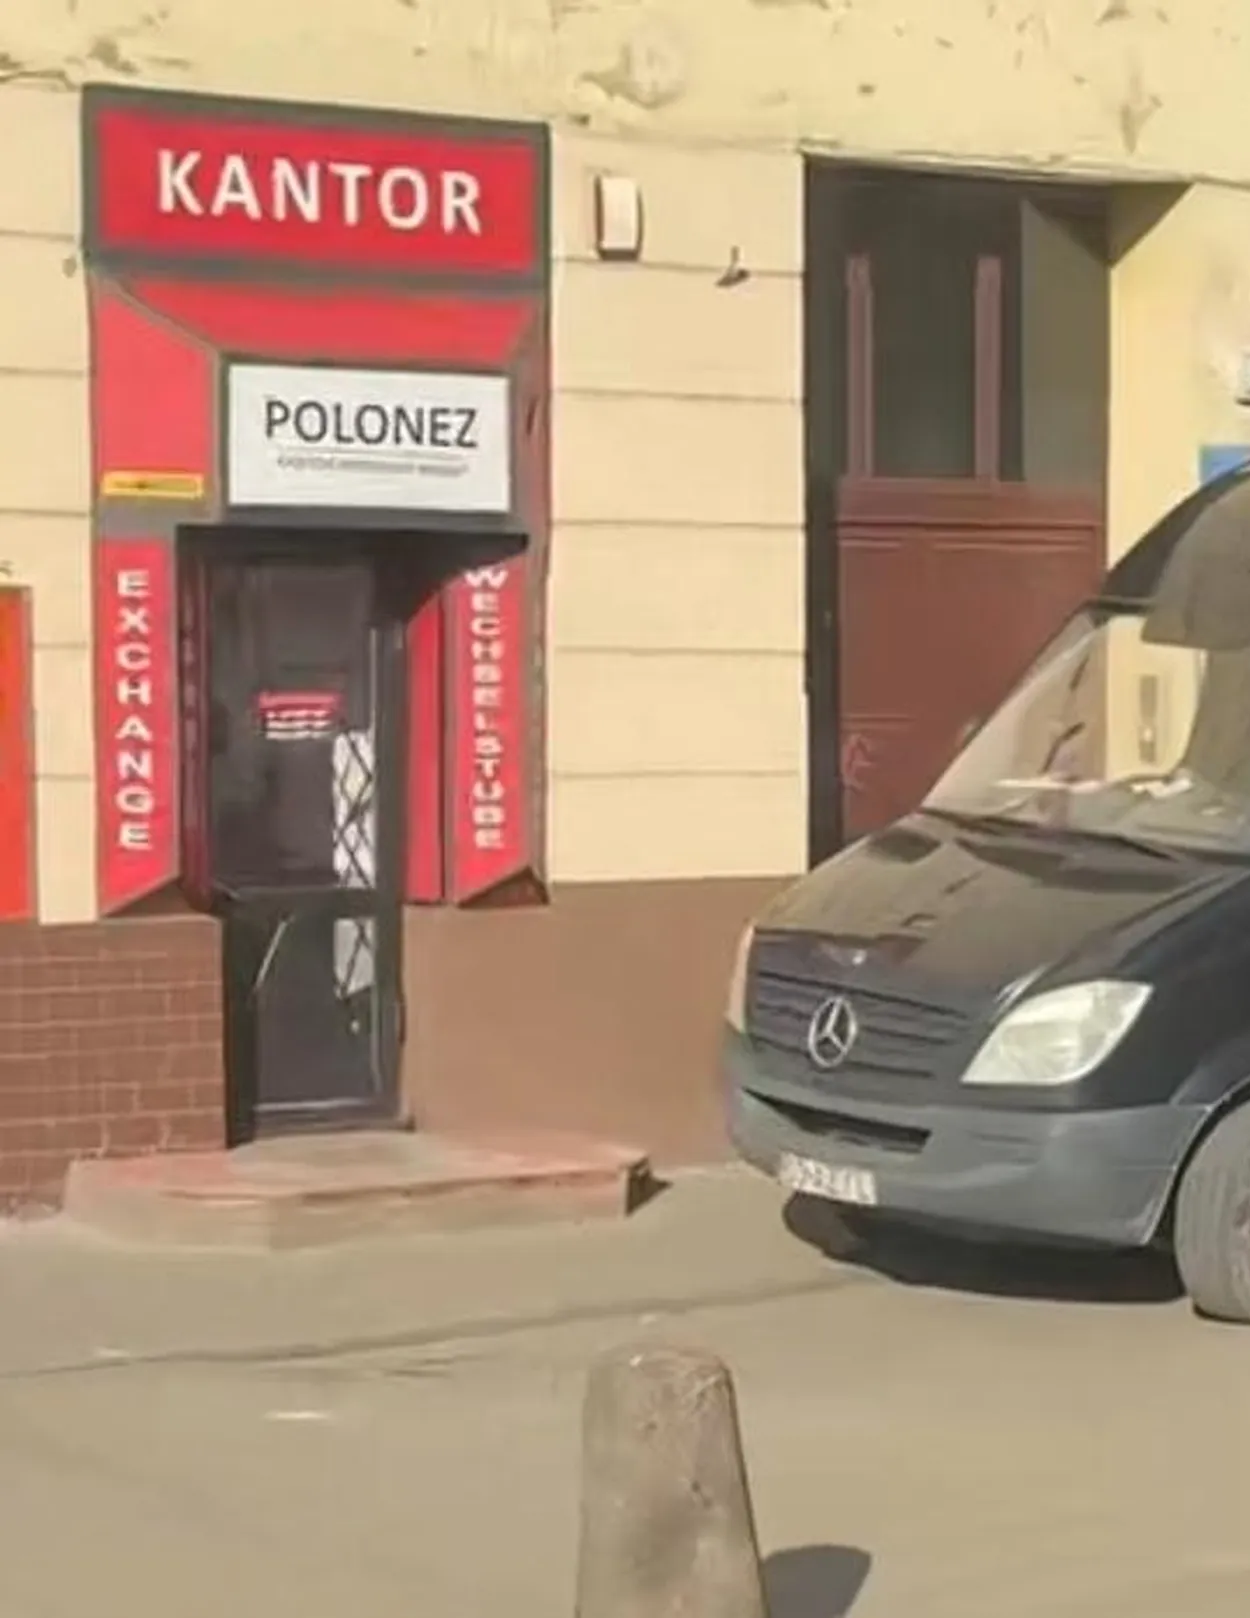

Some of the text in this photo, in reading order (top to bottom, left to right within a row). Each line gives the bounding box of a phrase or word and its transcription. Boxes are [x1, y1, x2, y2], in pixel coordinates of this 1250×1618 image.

[157, 148, 482, 236] KANTOR
[264, 399, 479, 448] POLONEZ
[115, 569, 154, 851] EXCHANGE
